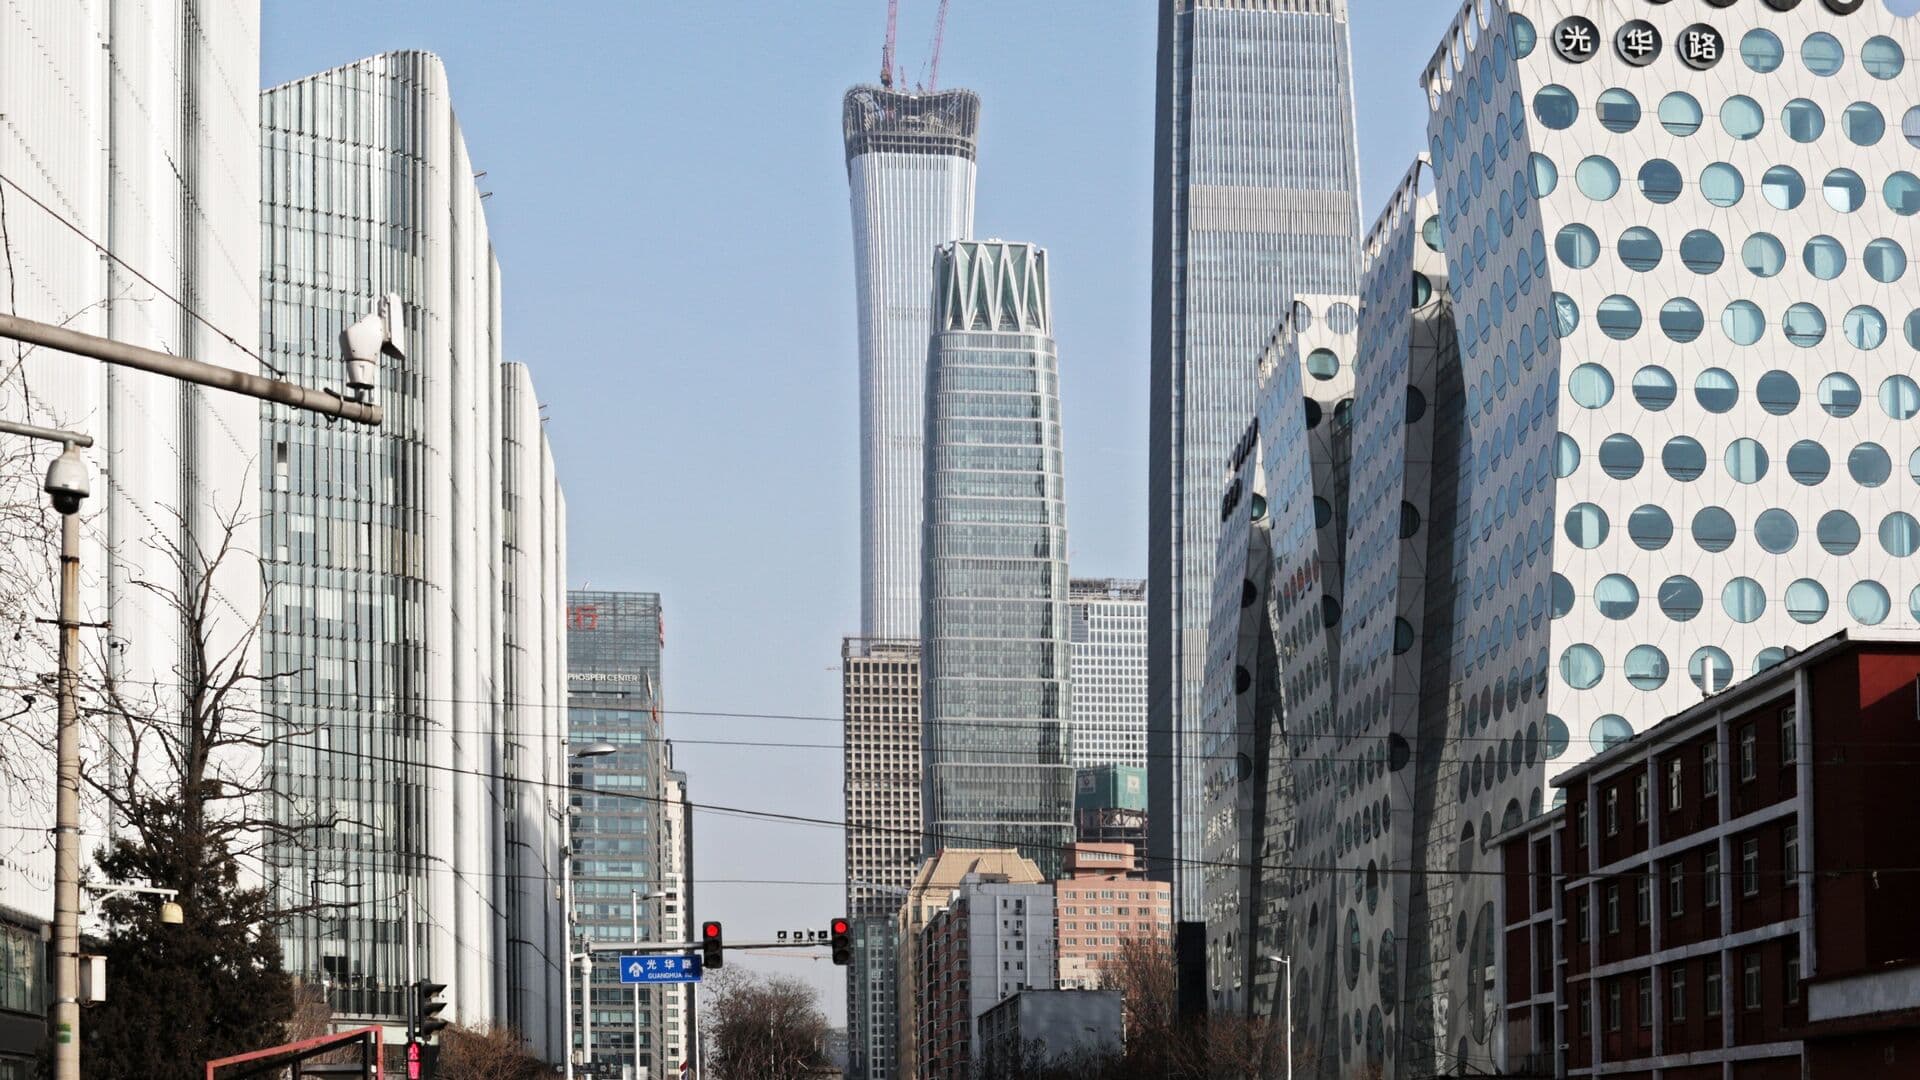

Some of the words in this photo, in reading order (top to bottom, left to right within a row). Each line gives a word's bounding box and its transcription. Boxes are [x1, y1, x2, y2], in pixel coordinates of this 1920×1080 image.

[1564, 25, 1716, 60] 光华路
[607, 673, 638, 682] CENTER
[646, 959, 692, 970] 光华路
